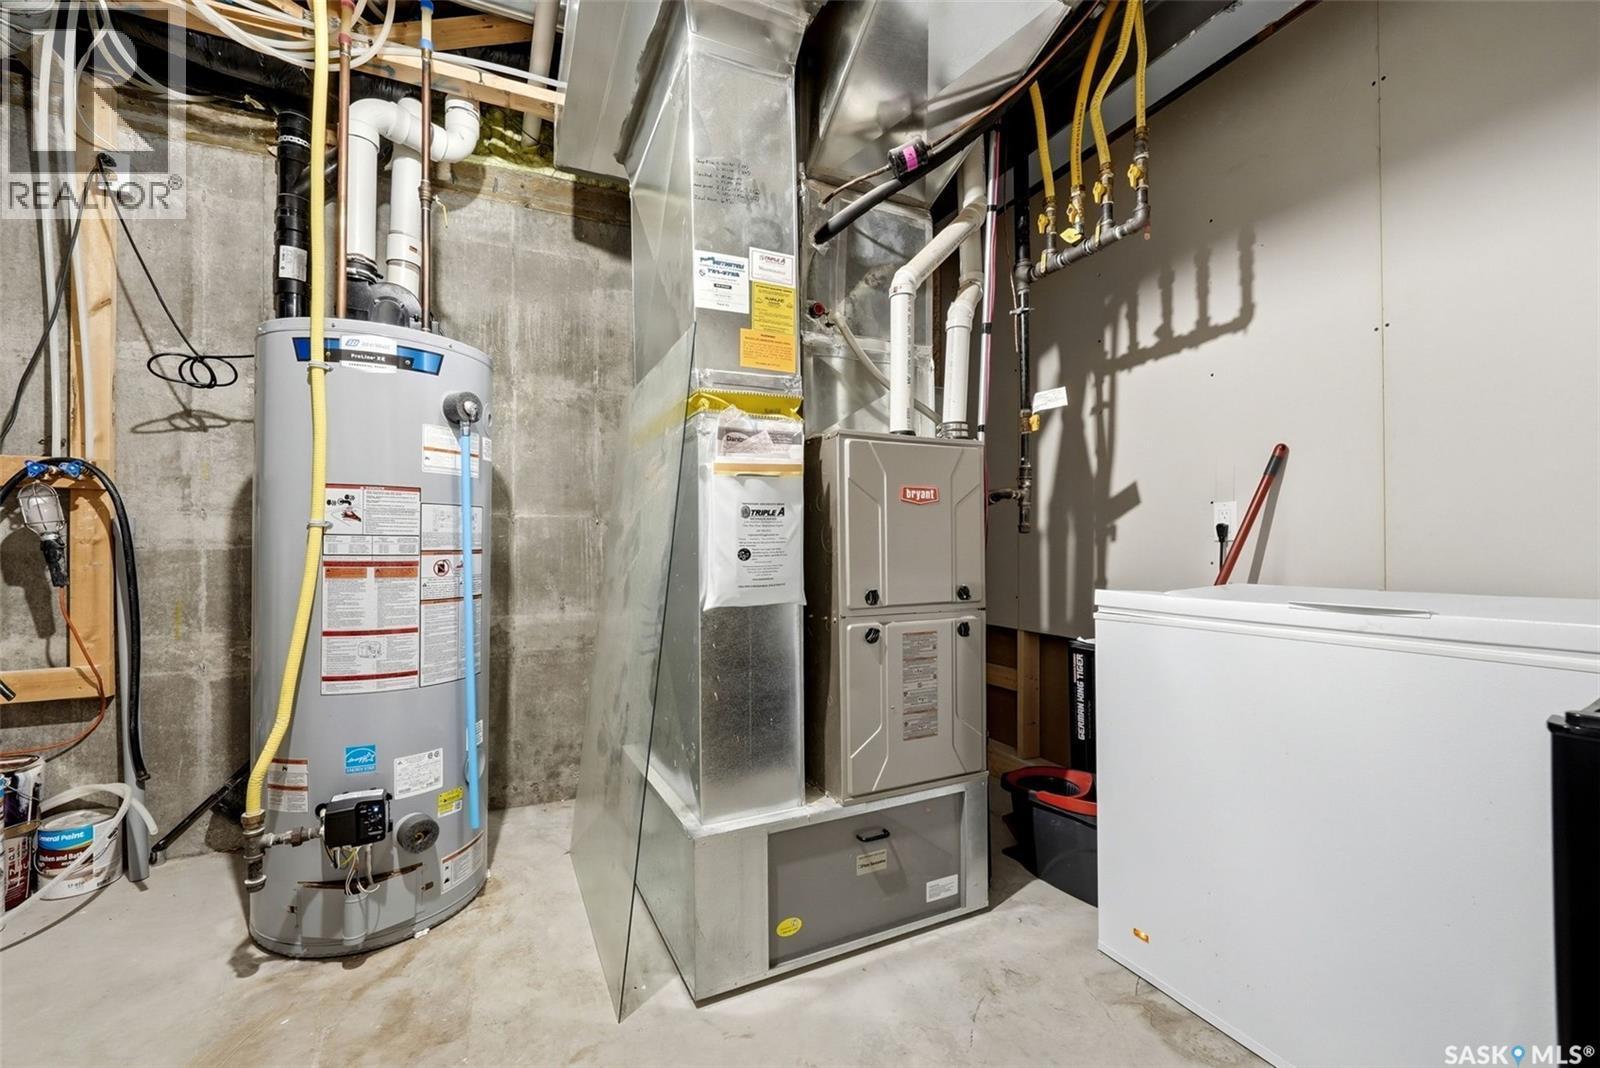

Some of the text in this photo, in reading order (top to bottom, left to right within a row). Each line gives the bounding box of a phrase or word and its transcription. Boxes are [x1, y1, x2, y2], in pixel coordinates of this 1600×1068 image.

[906, 488, 935, 501] bryant
[750, 506, 785, 517] TRIPLE A
[61, 832, 84, 841] Paint
